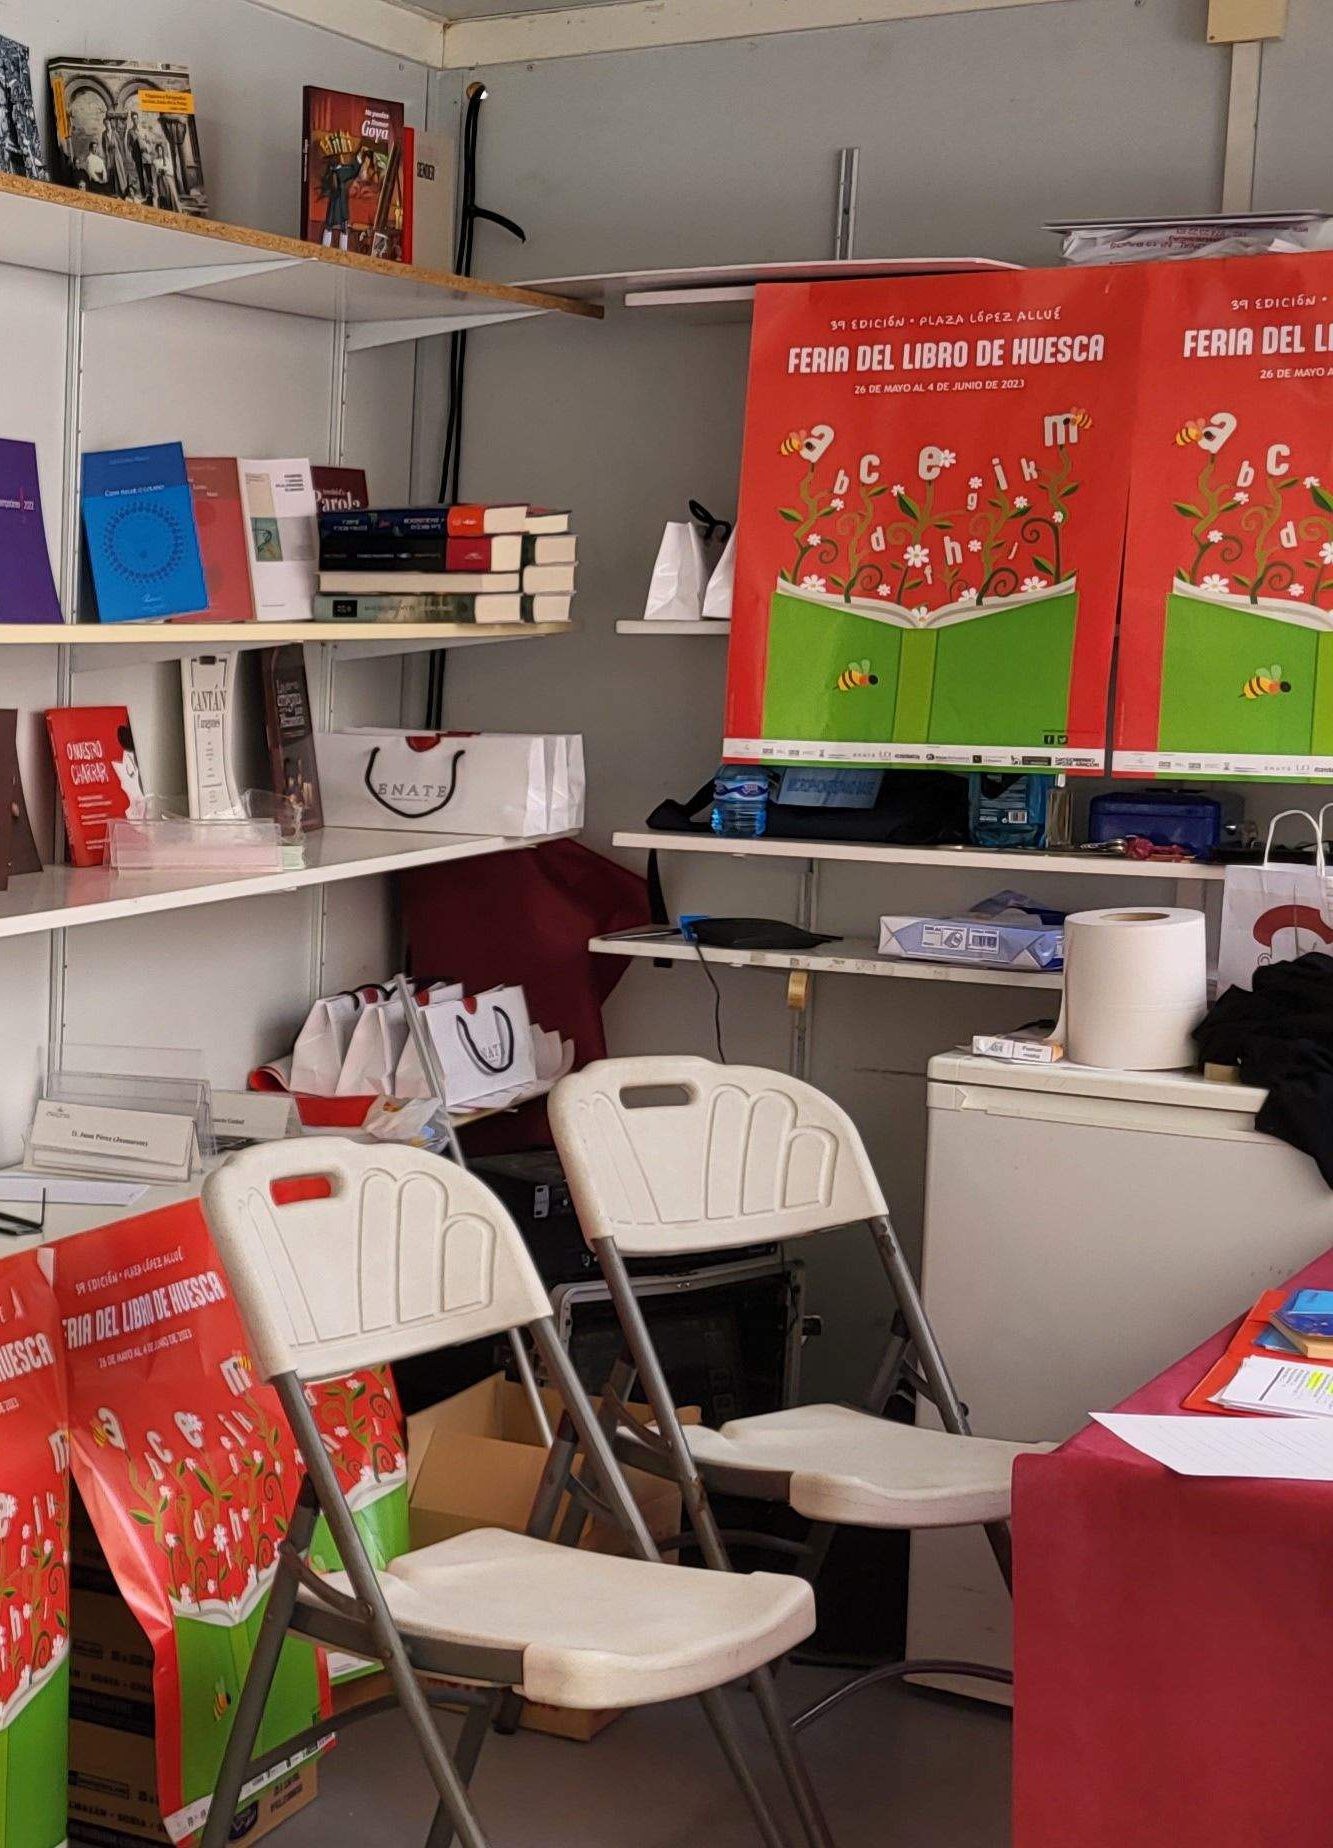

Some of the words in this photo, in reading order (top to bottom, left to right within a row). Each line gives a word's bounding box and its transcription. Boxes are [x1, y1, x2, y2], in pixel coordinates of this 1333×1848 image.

[361, 120, 389, 143] Goya
[1230, 299, 1249, 312] 39
[1254, 294, 1317, 311] EDICIÓN
[830, 319, 846, 331] 39
[851, 315, 905, 330] EDICIÓN
[919, 314, 965, 327] PLAZA
[969, 310, 1013, 323] LÓPEZ
[1016, 306, 1062, 321] ALLUÉ
[1182, 327, 1254, 358] FERIA
[1261, 323, 1307, 355] DEL
[787, 343, 849, 374] FERIA
[856, 344, 895, 372] DEL
[902, 340, 969, 370] LIBRO
[975, 338, 1006, 367] DE
[1011, 333, 1105, 366] HUESCA
[1260, 369, 1274, 380] 26
[1276, 368, 1292, 379] DE
[1294, 366, 1324, 379] MAYO
[854, 384, 866, 395] 26
[868, 383, 882, 394] DE
[883, 383, 911, 394] MAYO
[913, 382, 926, 393] AL
[927, 382, 934, 392] 4
[936, 381, 950, 392] DE
[952, 380, 983, 391] JUNIO
[985, 379, 999, 390] DE
[1001, 378, 1025, 389] 2023
[378, 782, 447, 798] ENATE
[62, 1313, 92, 1349] RIA
[95, 1305, 119, 1341] DEL
[121, 1292, 155, 1333] LIBRO
[151, 1287, 171, 1321] DE
[168, 1270, 227, 1315] HUESCA
